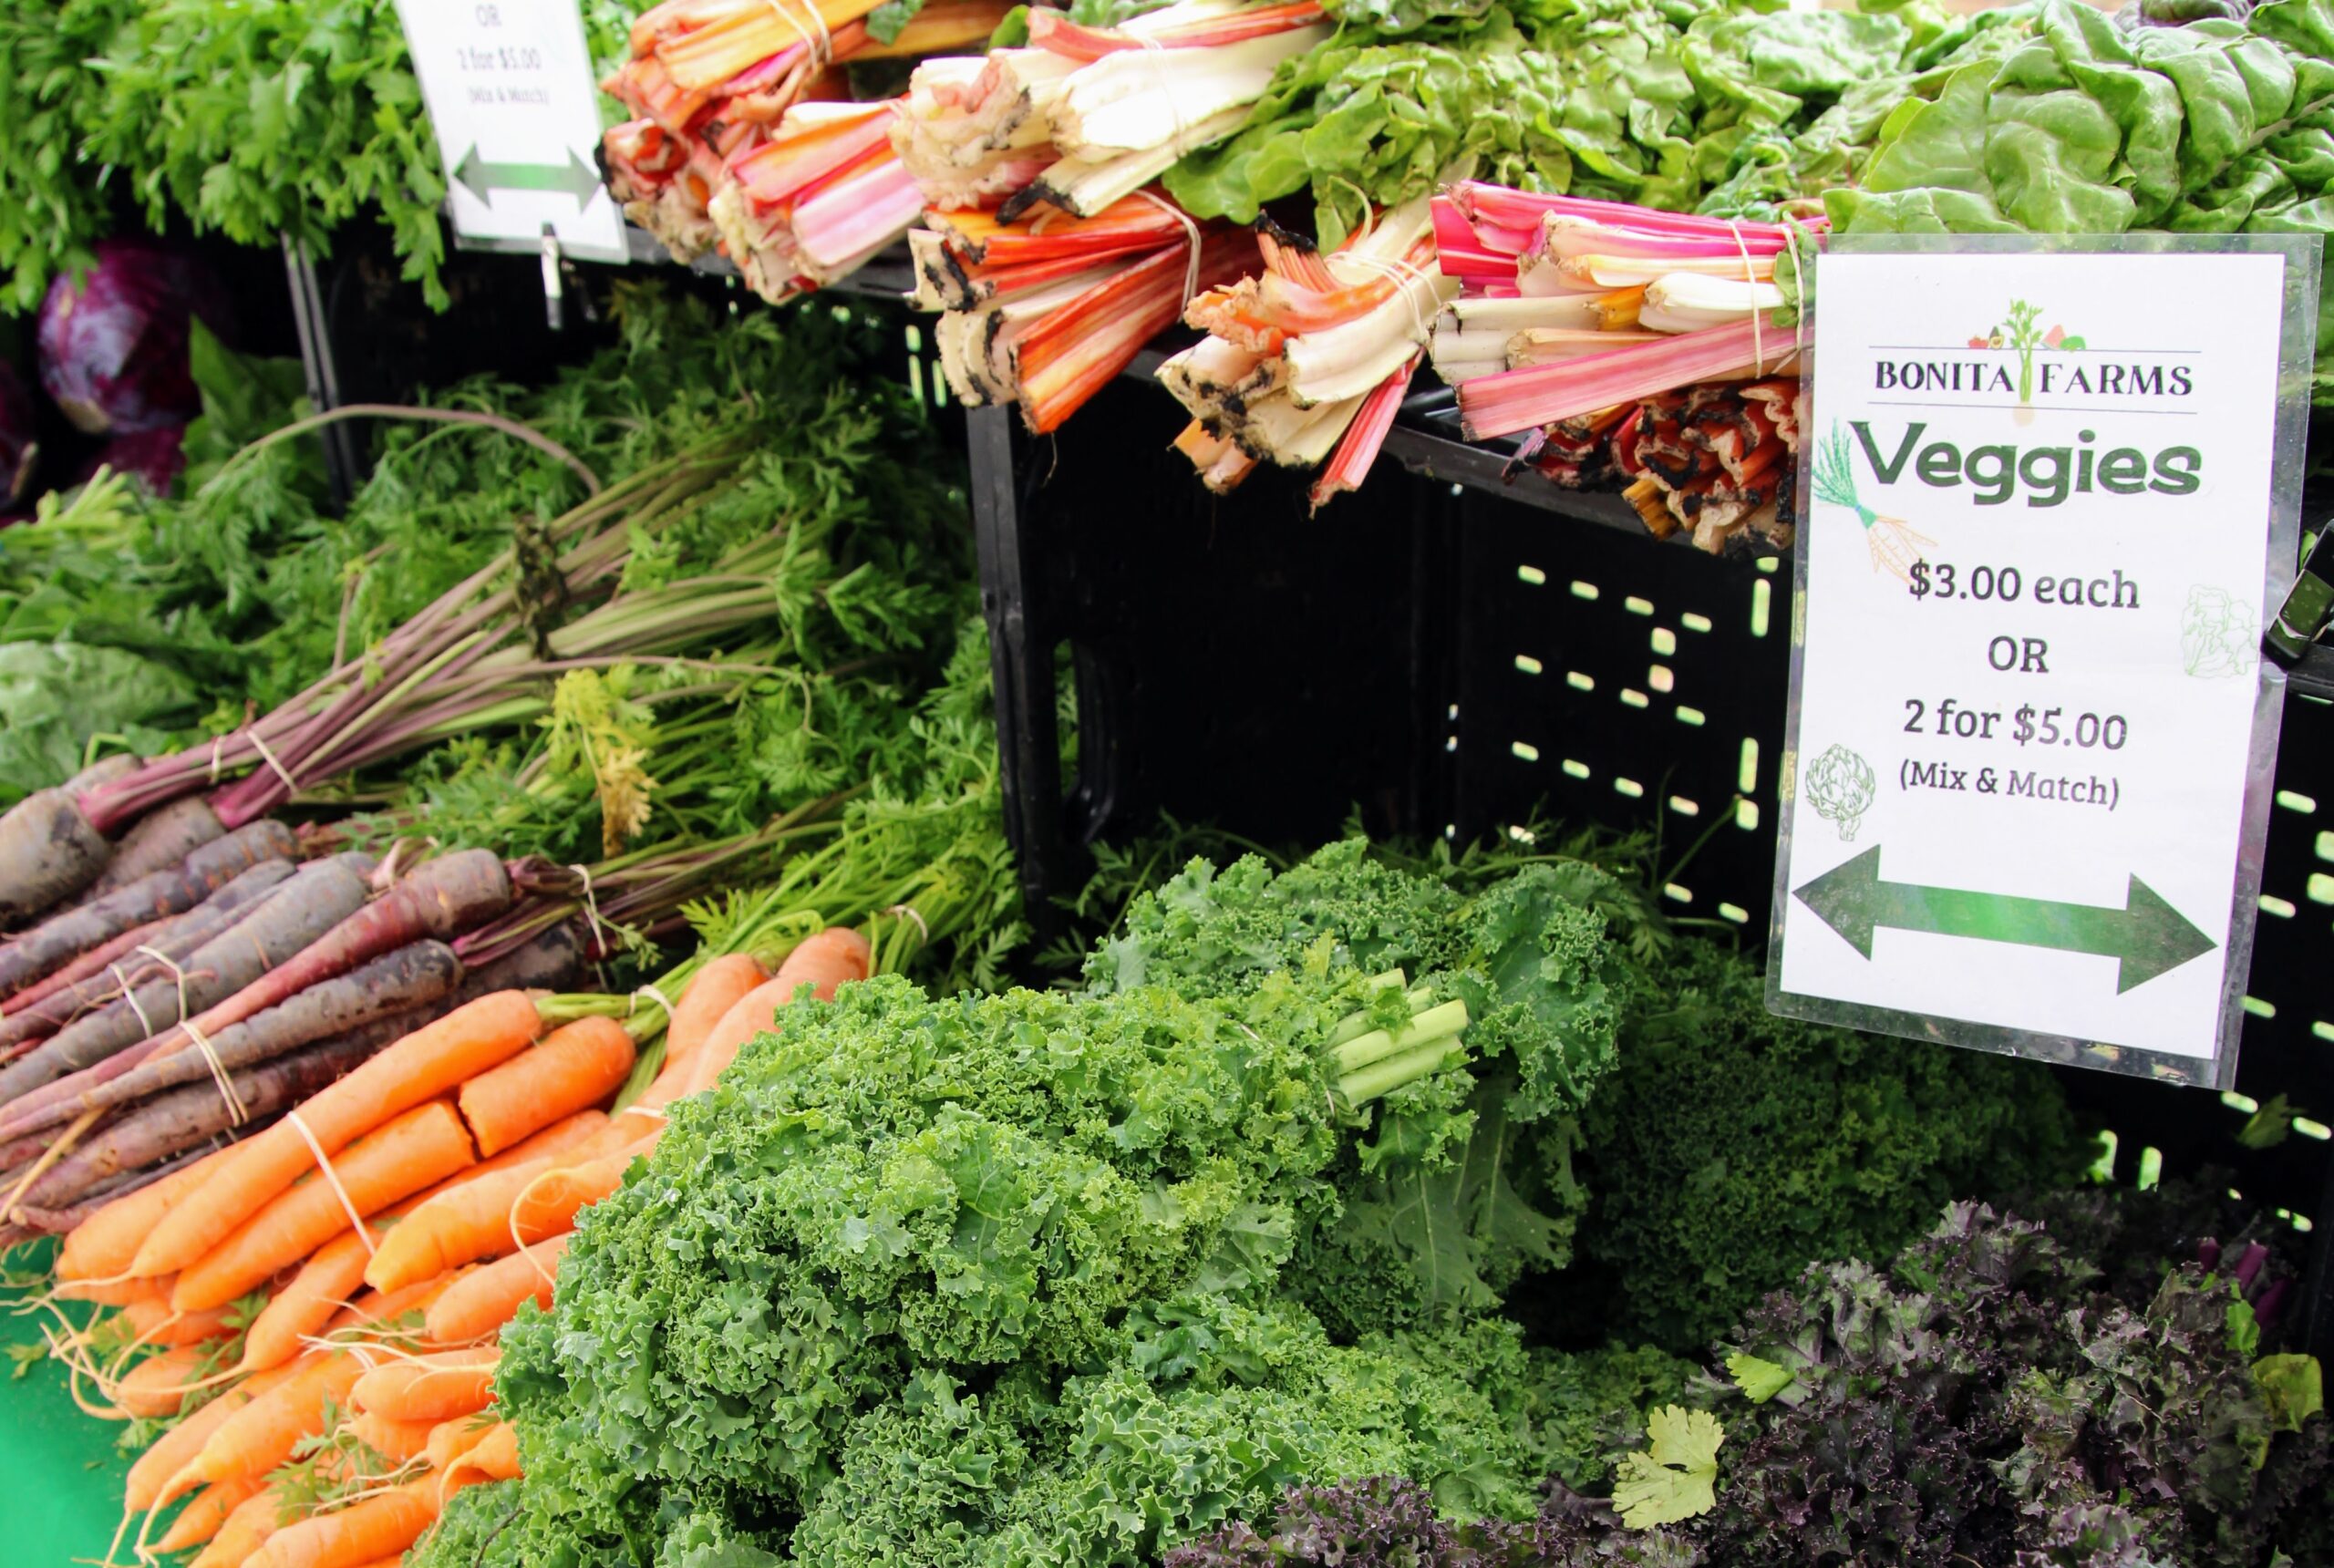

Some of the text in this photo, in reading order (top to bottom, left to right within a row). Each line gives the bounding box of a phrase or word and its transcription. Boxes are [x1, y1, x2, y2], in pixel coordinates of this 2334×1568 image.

[475, 4, 502, 26] OR
[1874, 361, 2194, 397] BONITA FARMS
[1849, 420, 2203, 508] Veggies
[1908, 558, 2141, 610] $3.00 each
[1988, 634, 2050, 675] OR
[1904, 698, 2128, 750] 2 for $5.00
[1899, 759, 2120, 811] (Mix & Match)
